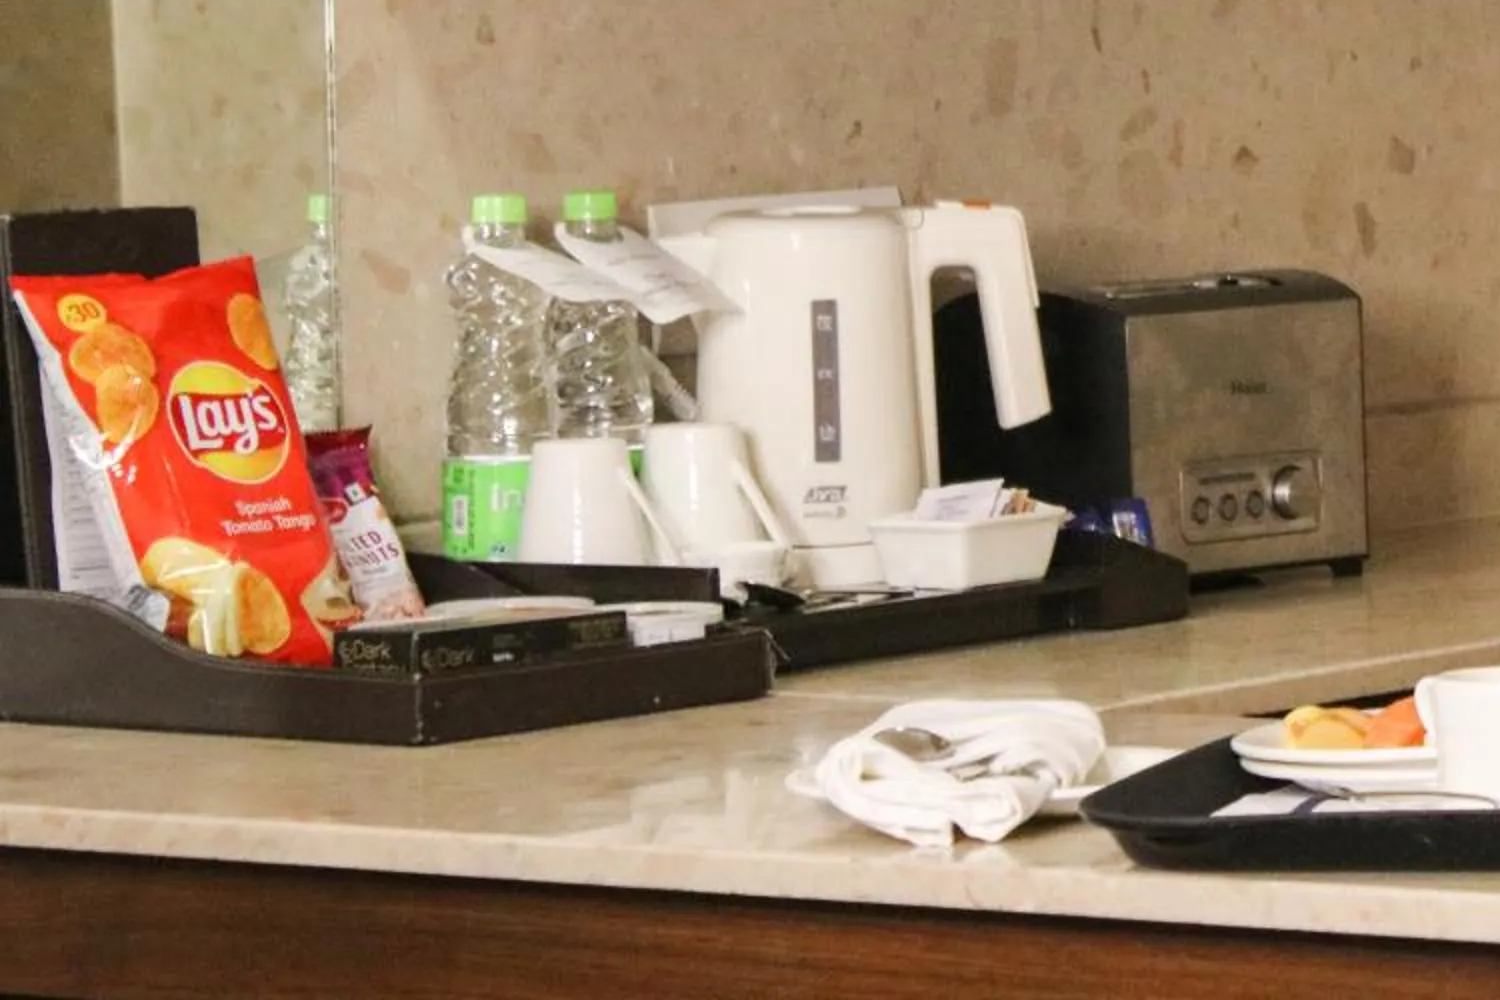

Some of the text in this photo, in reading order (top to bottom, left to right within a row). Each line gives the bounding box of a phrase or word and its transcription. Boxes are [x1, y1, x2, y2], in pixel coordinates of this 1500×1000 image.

[178, 386, 277, 454] Lay's
[234, 496, 292, 519] Spanish
[219, 519, 273, 536] Tomato
